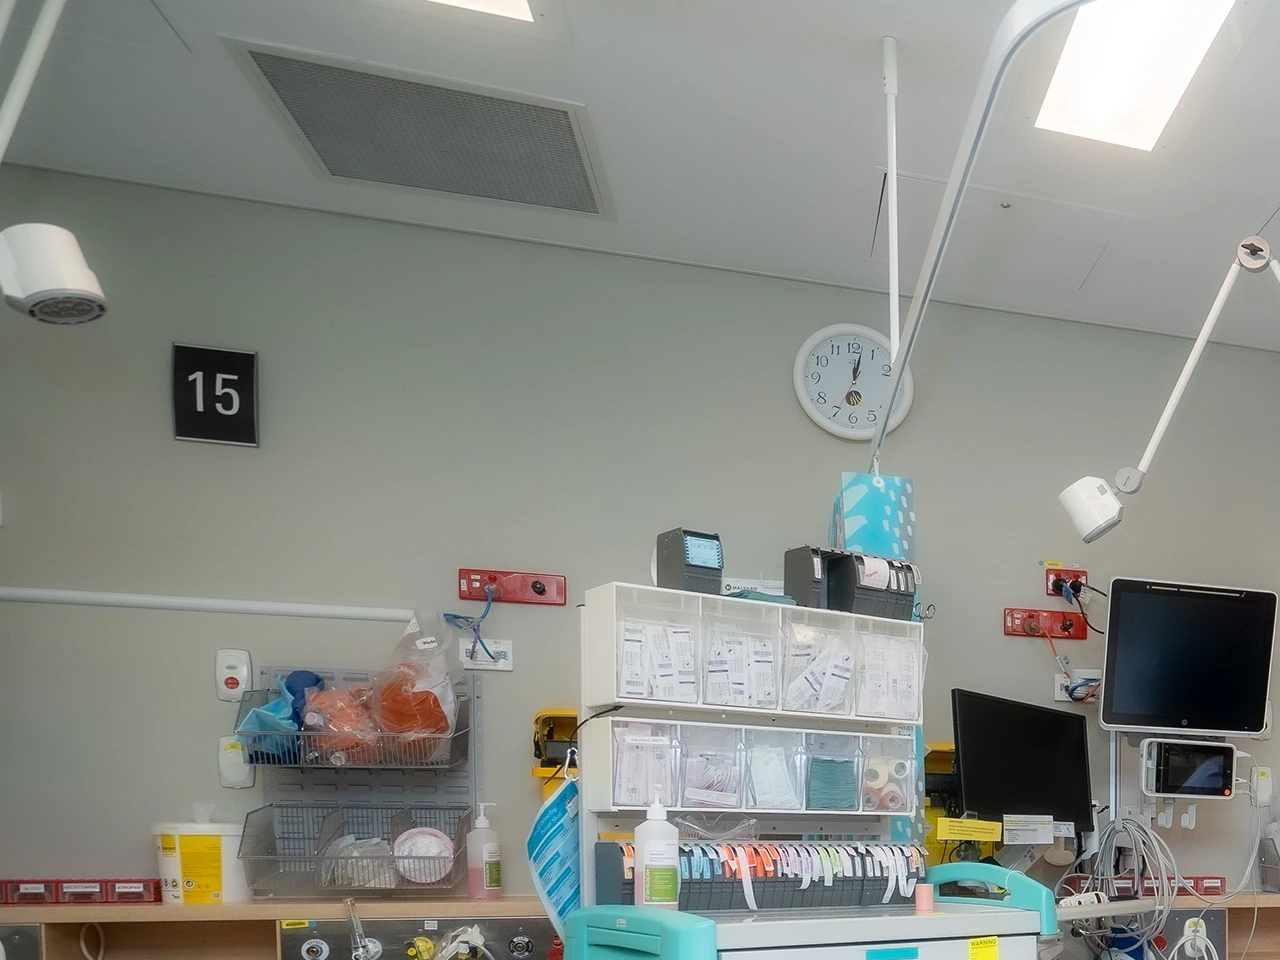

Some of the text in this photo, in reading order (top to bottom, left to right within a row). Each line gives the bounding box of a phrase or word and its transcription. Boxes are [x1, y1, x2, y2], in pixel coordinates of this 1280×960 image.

[830, 344, 840, 356] 11
[847, 342, 861, 354] 12
[870, 349, 875, 360] 1
[815, 355, 829, 367] 10
[881, 364, 892, 377] 2
[811, 372, 821, 385] 9
[188, 371, 240, 416] 15
[816, 391, 827, 404] 8
[831, 405, 842, 417] 7
[866, 410, 877, 422] 5
[848, 411, 858, 424] 6
[970, 939, 997, 947] WARNING
